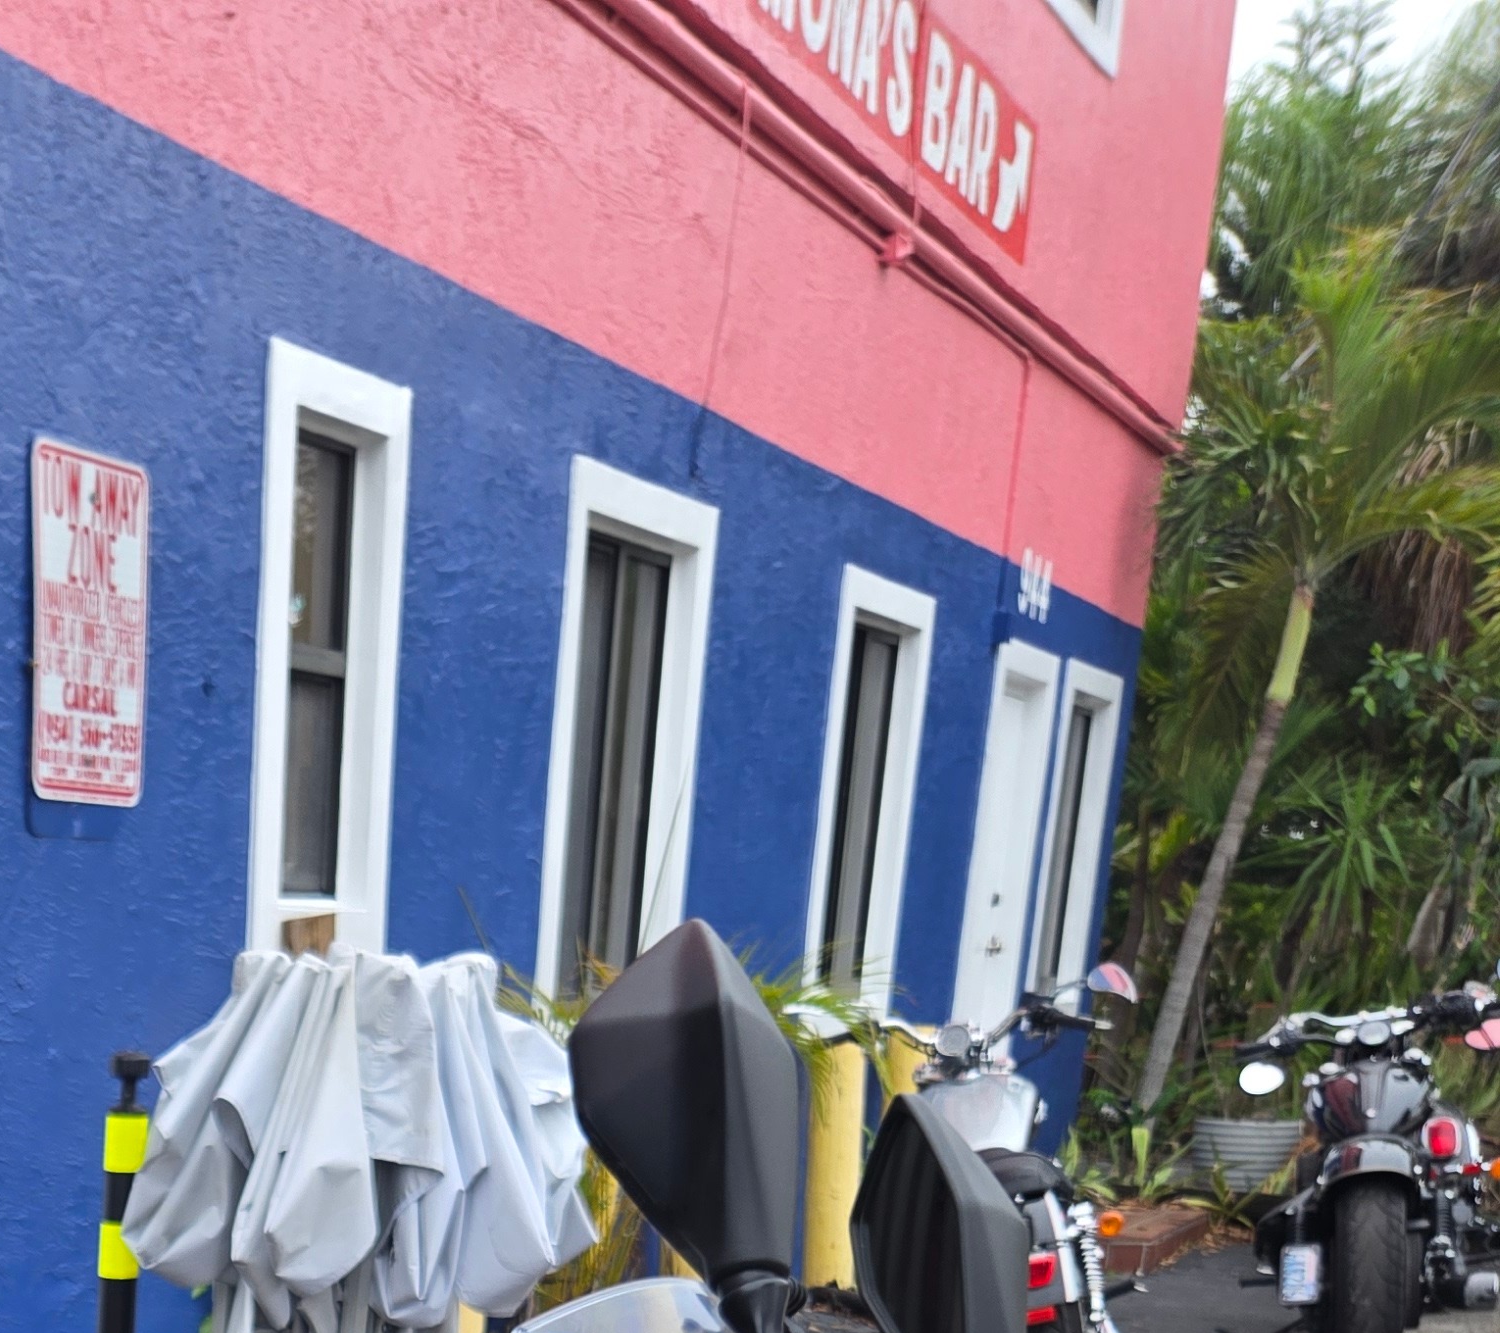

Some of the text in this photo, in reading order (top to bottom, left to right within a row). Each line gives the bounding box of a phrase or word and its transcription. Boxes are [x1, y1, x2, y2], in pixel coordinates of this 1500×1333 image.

[758, 0, 999, 217] NA'S BAR
[41, 453, 141, 539] TOW AWAY
[67, 523, 117, 594] ZONE
